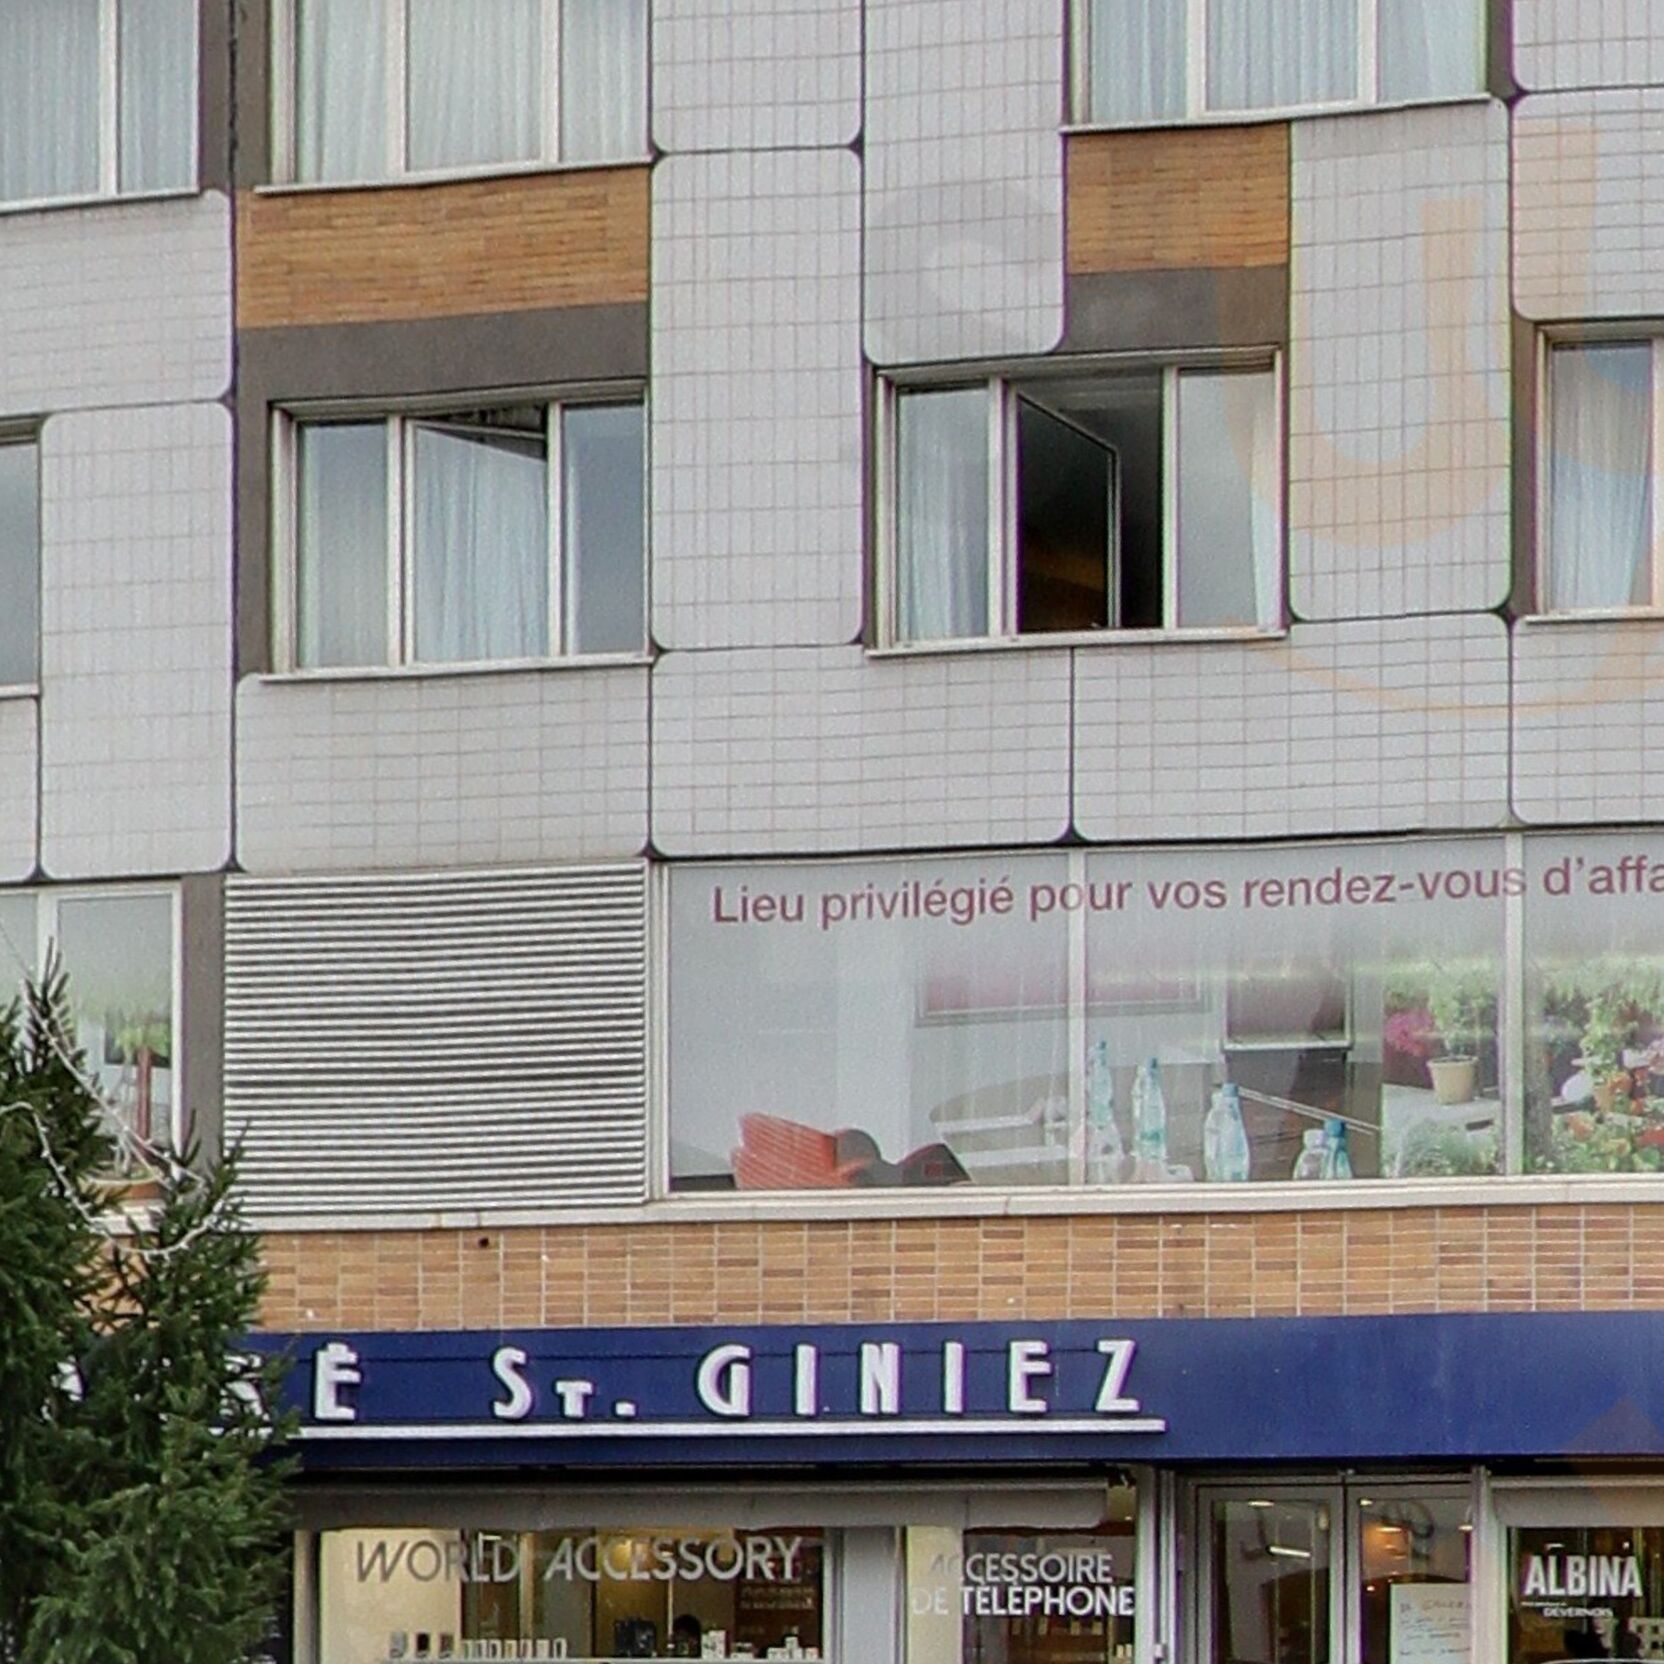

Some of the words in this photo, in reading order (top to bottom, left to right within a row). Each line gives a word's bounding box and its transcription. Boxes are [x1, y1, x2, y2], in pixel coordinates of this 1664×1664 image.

[712, 885, 806, 923] Lieu
[821, 876, 1015, 930] privilégié
[1029, 883, 1133, 929] pour
[1147, 877, 1227, 911] vos
[1243, 861, 1525, 908] rendez-vous
[696, 1338, 1141, 1417] GINIEZ
[356, 1539, 522, 1583] WORLD
[544, 1535, 803, 1583] ACCESSORY
[930, 1552, 1113, 1584] ACCESSOIRE
[1524, 1555, 1643, 1597] ALBINA
[913, 1588, 949, 1616] DE
